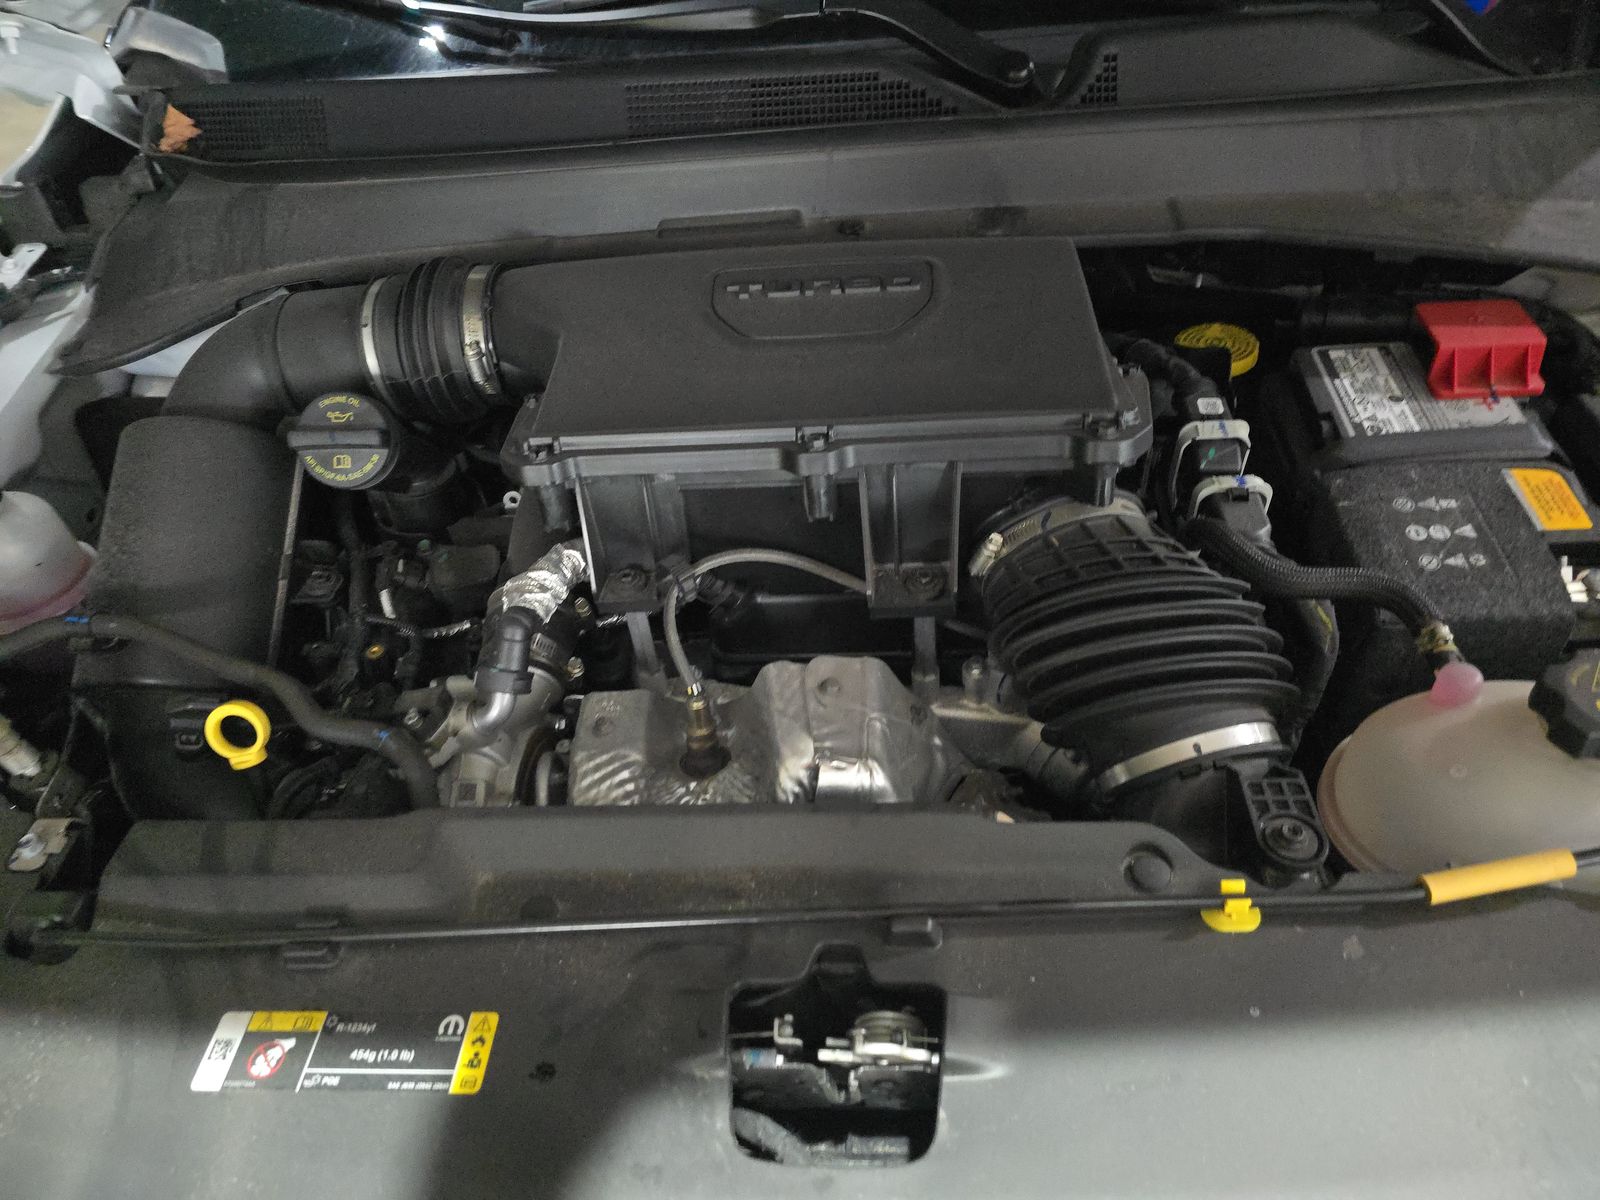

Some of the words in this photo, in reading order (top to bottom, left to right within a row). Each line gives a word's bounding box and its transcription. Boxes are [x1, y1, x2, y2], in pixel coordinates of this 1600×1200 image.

[318, 396, 347, 409] ENGINE
[347, 397, 361, 409] OIL
[349, 1048, 377, 1063] 454g
[377, 1048, 399, 1063] (1.0
[399, 1048, 415, 1063] lb)
